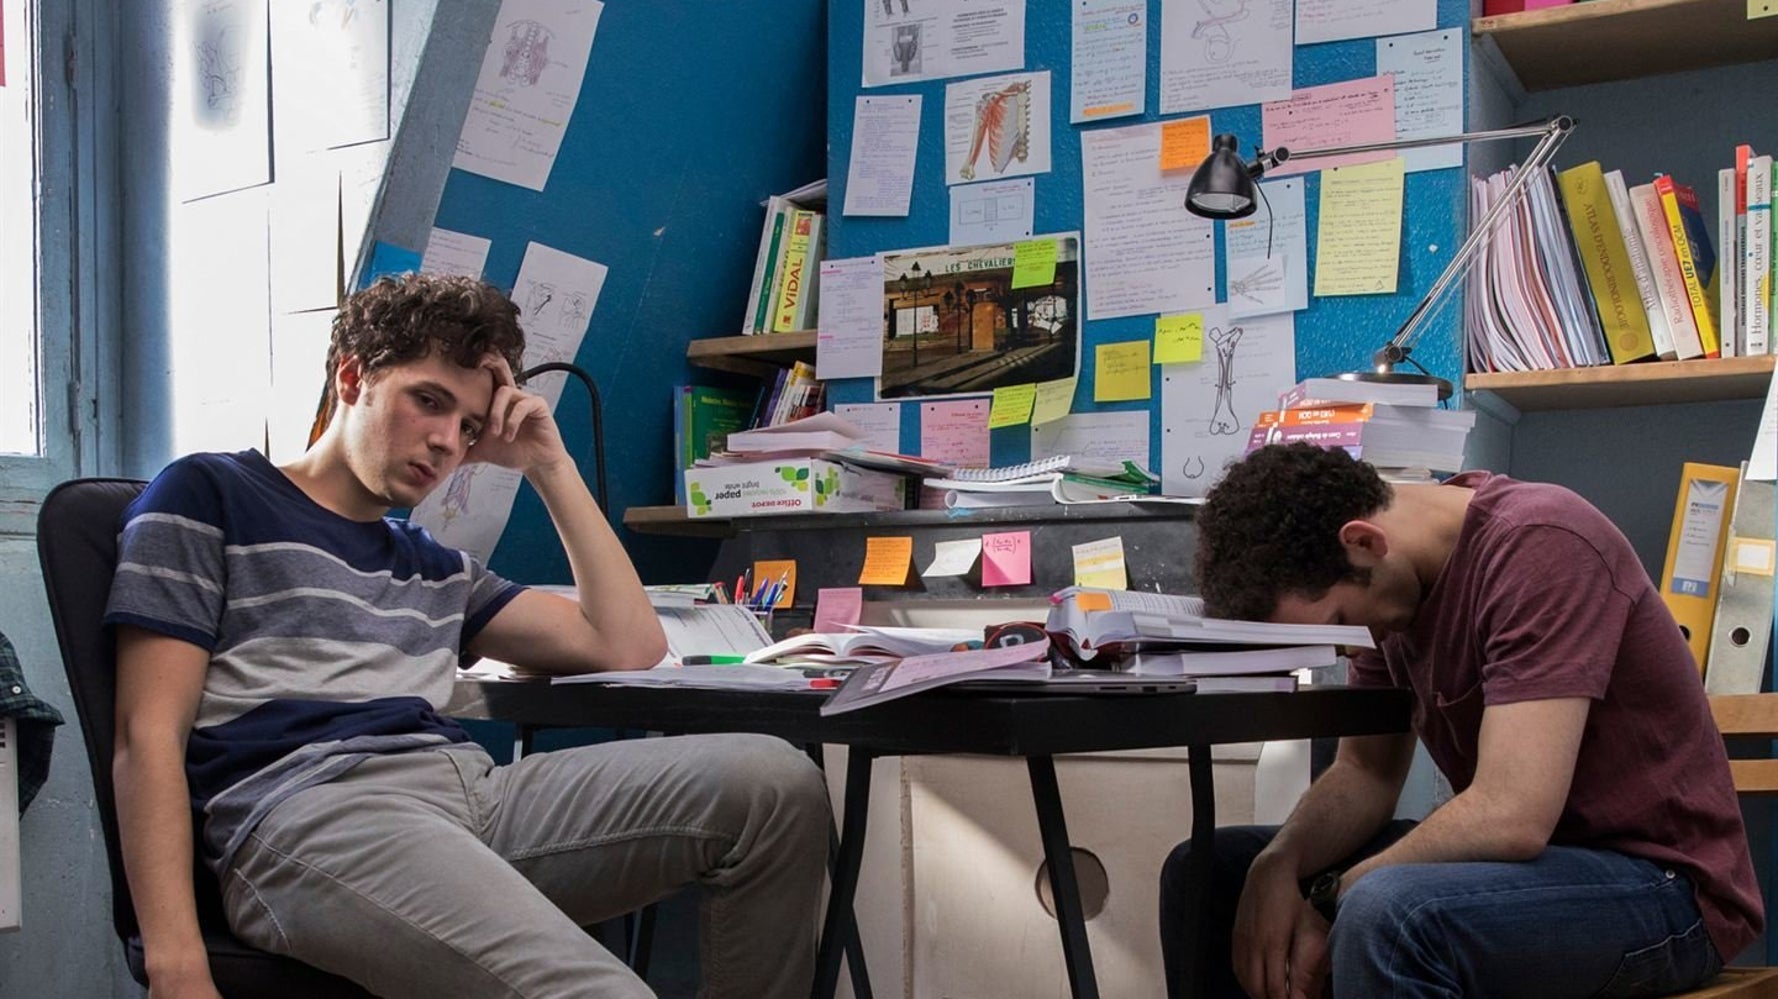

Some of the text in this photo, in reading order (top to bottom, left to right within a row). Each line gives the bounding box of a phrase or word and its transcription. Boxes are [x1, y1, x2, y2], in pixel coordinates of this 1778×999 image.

[1672, 224, 1685, 245] QCM
[1754, 228, 1762, 239] et
[945, 265, 960, 273] LES
[1583, 202, 1630, 329] ATLAS D'ENDOCRINOLOGIE
[1624, 227, 1657, 311] Atlas d'anatomie
[1682, 259, 1694, 279] UE7
[1660, 258, 1684, 324] Radiothérapie
[1688, 281, 1703, 308] TOTAL
[1751, 275, 1763, 334] Hormones,
[715, 490, 742, 500] paper
[741, 481, 760, 490] bright
[752, 498, 801, 508] Office DEPOT
